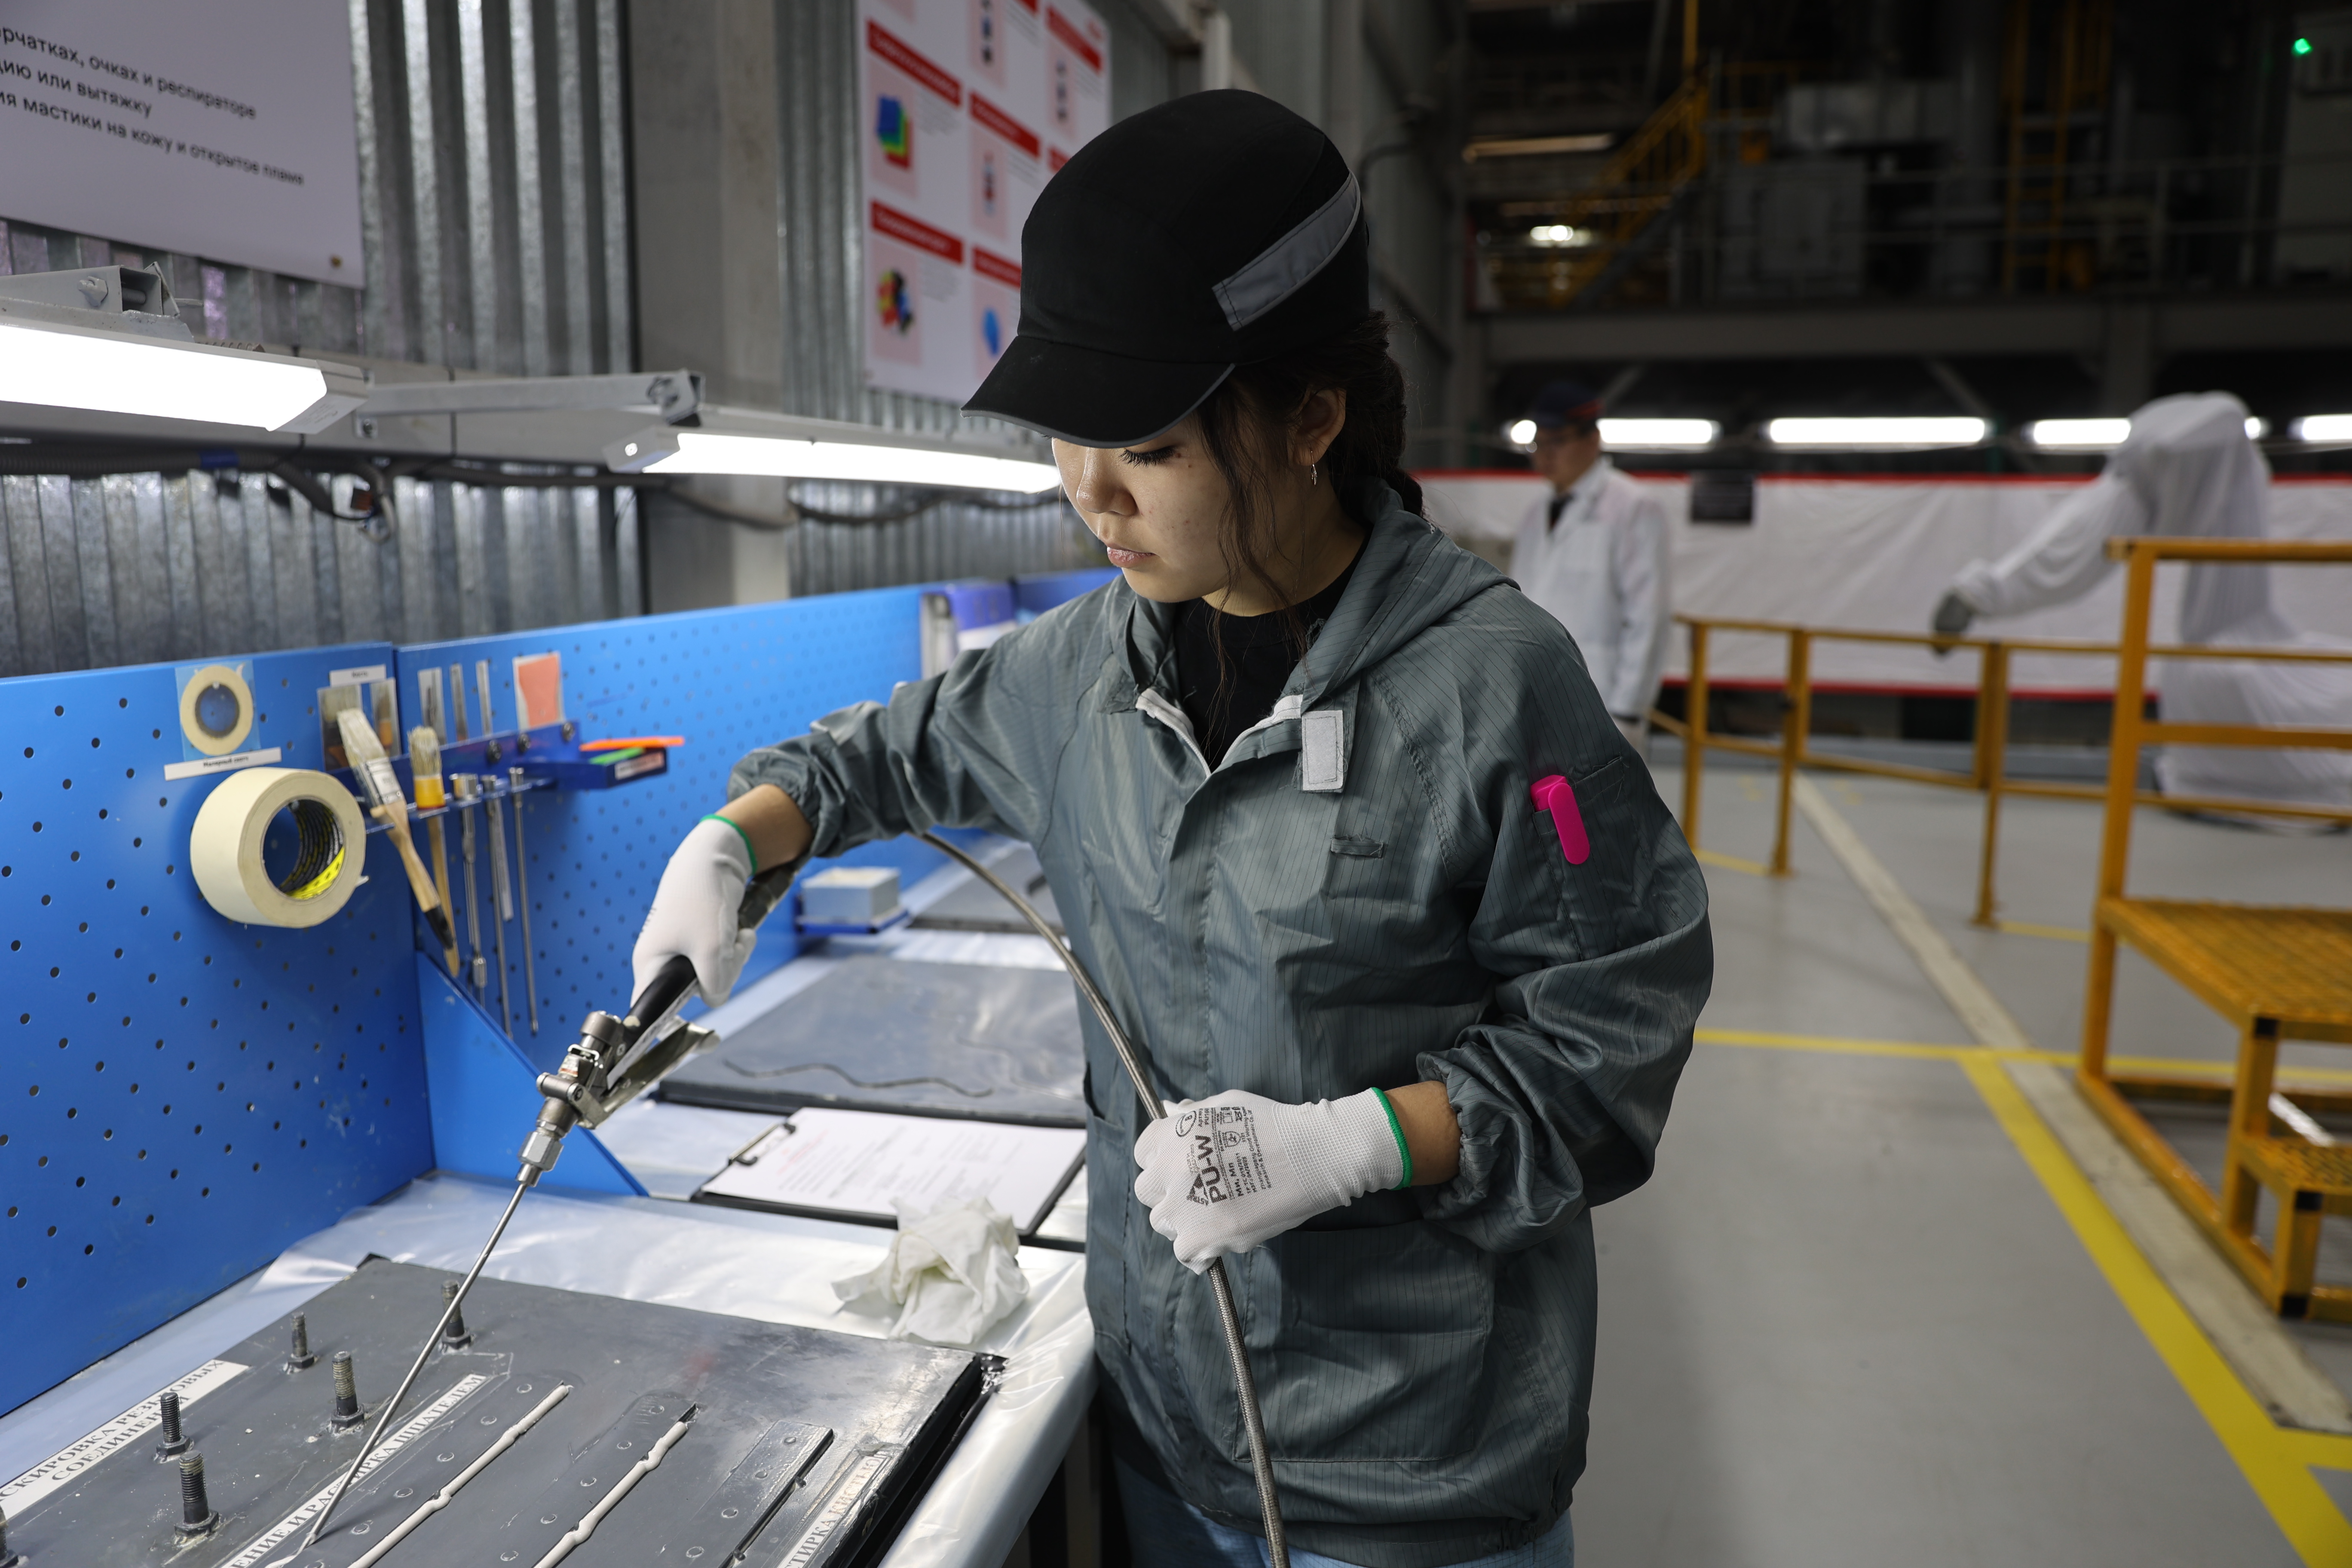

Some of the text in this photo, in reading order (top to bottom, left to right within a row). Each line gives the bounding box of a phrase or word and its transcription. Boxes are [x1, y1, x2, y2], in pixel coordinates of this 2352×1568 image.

[0, 27, 257, 120] рчатках, очках и респираторе
[38, 70, 71, 92] или
[77, 82, 152, 119] вытяжку
[23, 97, 102, 131] мастики
[107, 121, 126, 138] на
[132, 128, 172, 154] кожу
[176, 141, 187, 154] и
[190, 144, 260, 175] открытое
[262, 164, 304, 187] пламя
[1251, 1124, 1262, 1157] Development
[1195, 1135, 1227, 1203] PU-W
[1229, 1163, 1244, 1197] Ми, Мп
[1253, 1153, 1266, 1189] Zhangjiagang
[1260, 1162, 1271, 1188] Research
[0, 1361, 225, 1501] СКИРОВКА РЕЗЬОВЫХ
[286, 1515, 308, 1526] И
[303, 1447, 397, 1513] РАСИРКА
[395, 1376, 484, 1445] ШПАТЕЛЕМ
[827, 1458, 881, 1514] КИСТЬЮ
